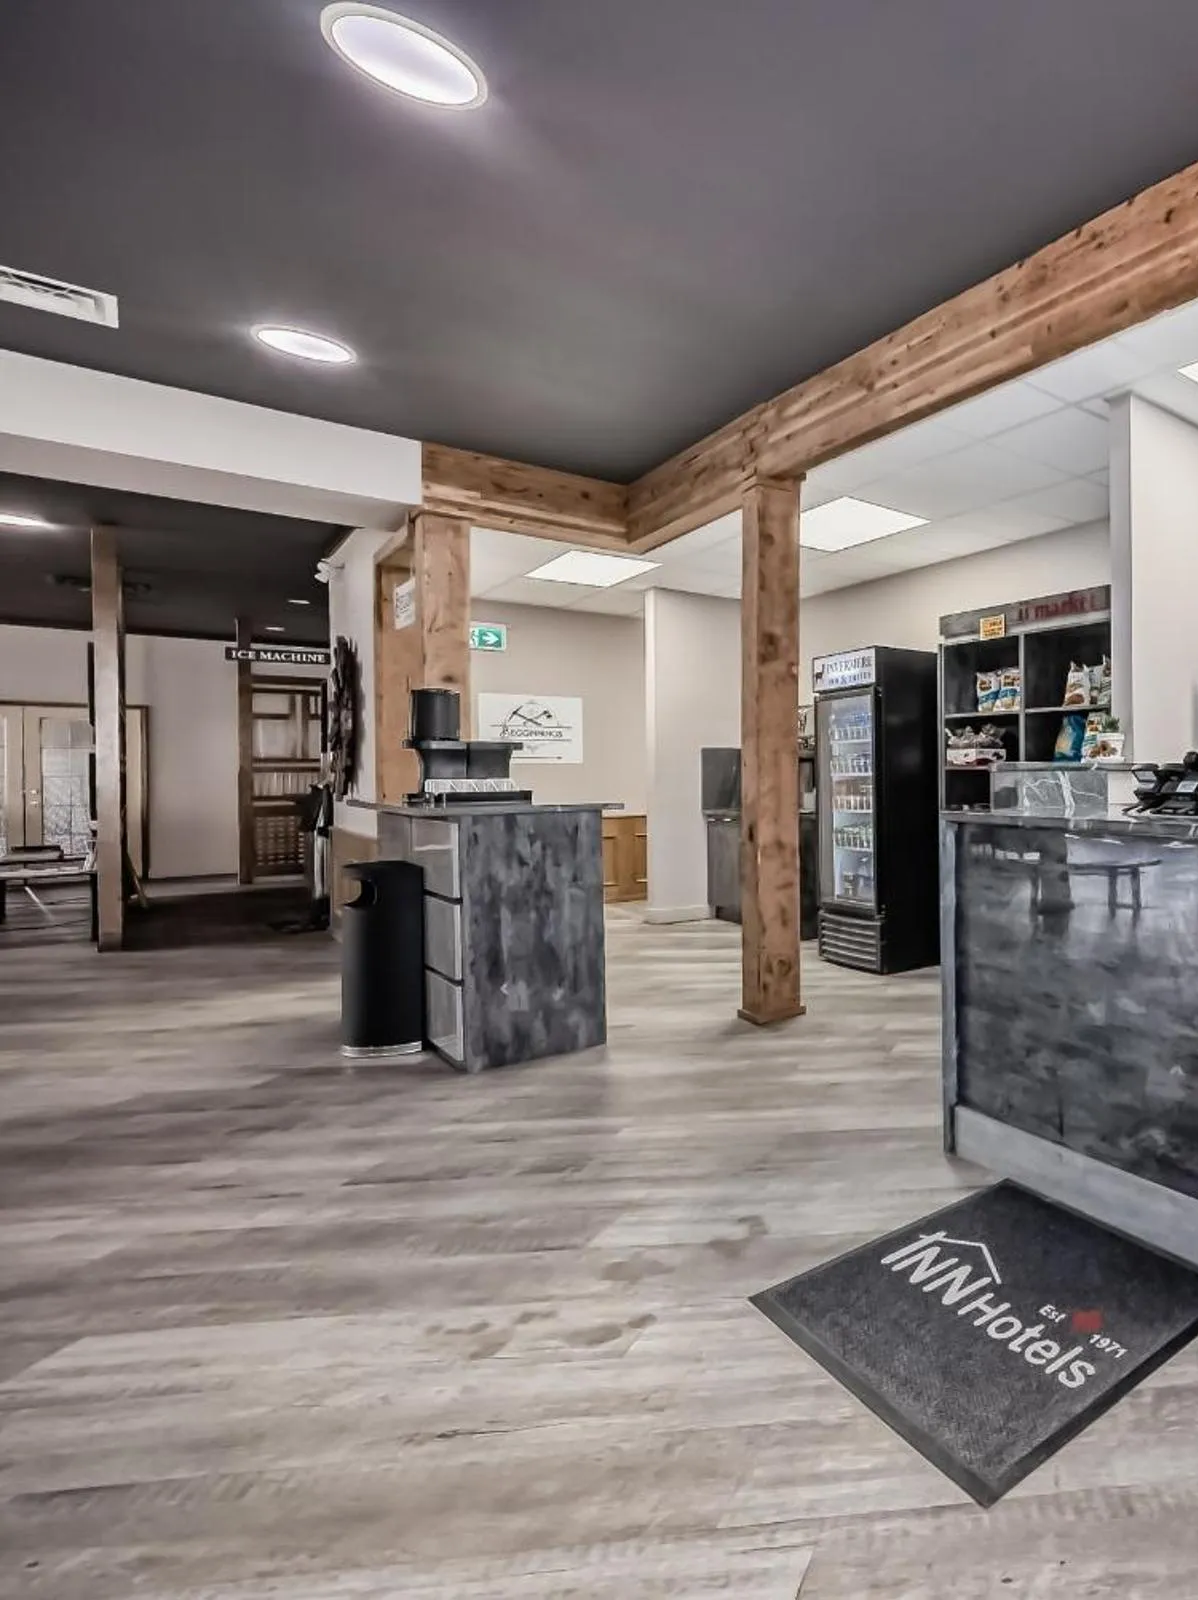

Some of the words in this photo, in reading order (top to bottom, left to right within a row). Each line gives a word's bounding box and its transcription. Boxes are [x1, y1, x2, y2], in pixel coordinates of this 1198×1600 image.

[231, 650, 256, 660] ICE
[260, 651, 326, 663] MACHINE
[1039, 1304, 1067, 1324] Est
[1088, 1333, 1129, 1359] 1971
